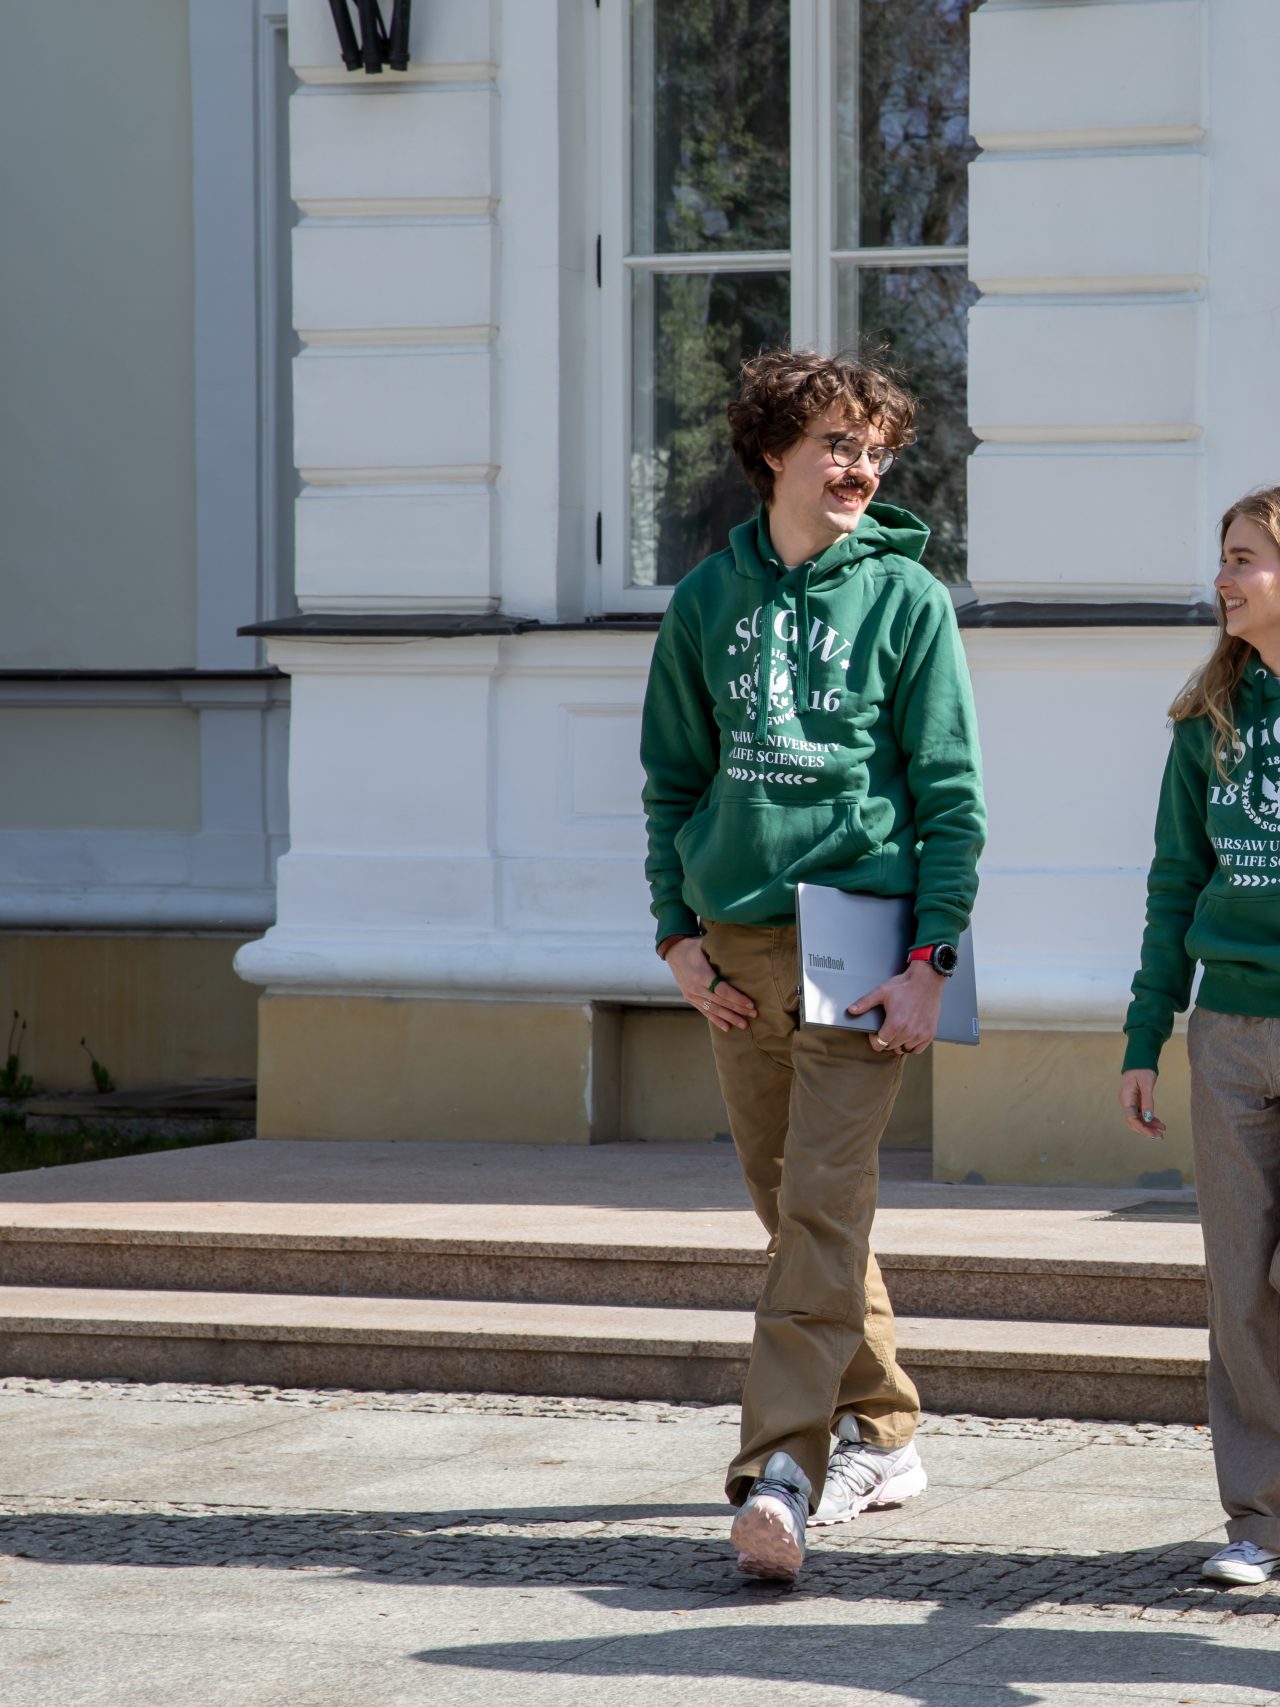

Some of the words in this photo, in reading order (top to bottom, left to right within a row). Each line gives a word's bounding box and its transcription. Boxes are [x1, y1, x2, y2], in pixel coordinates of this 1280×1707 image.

[728, 673, 752, 700] 18
[809, 687, 841, 712] 16
[757, 734, 841, 753] NIVERSITY
[756, 750, 825, 768] SCIENCES
[1209, 783, 1239, 806] 18
[1236, 854, 1266, 867] LIFE
[808, 953, 845, 971] ThinkBook
